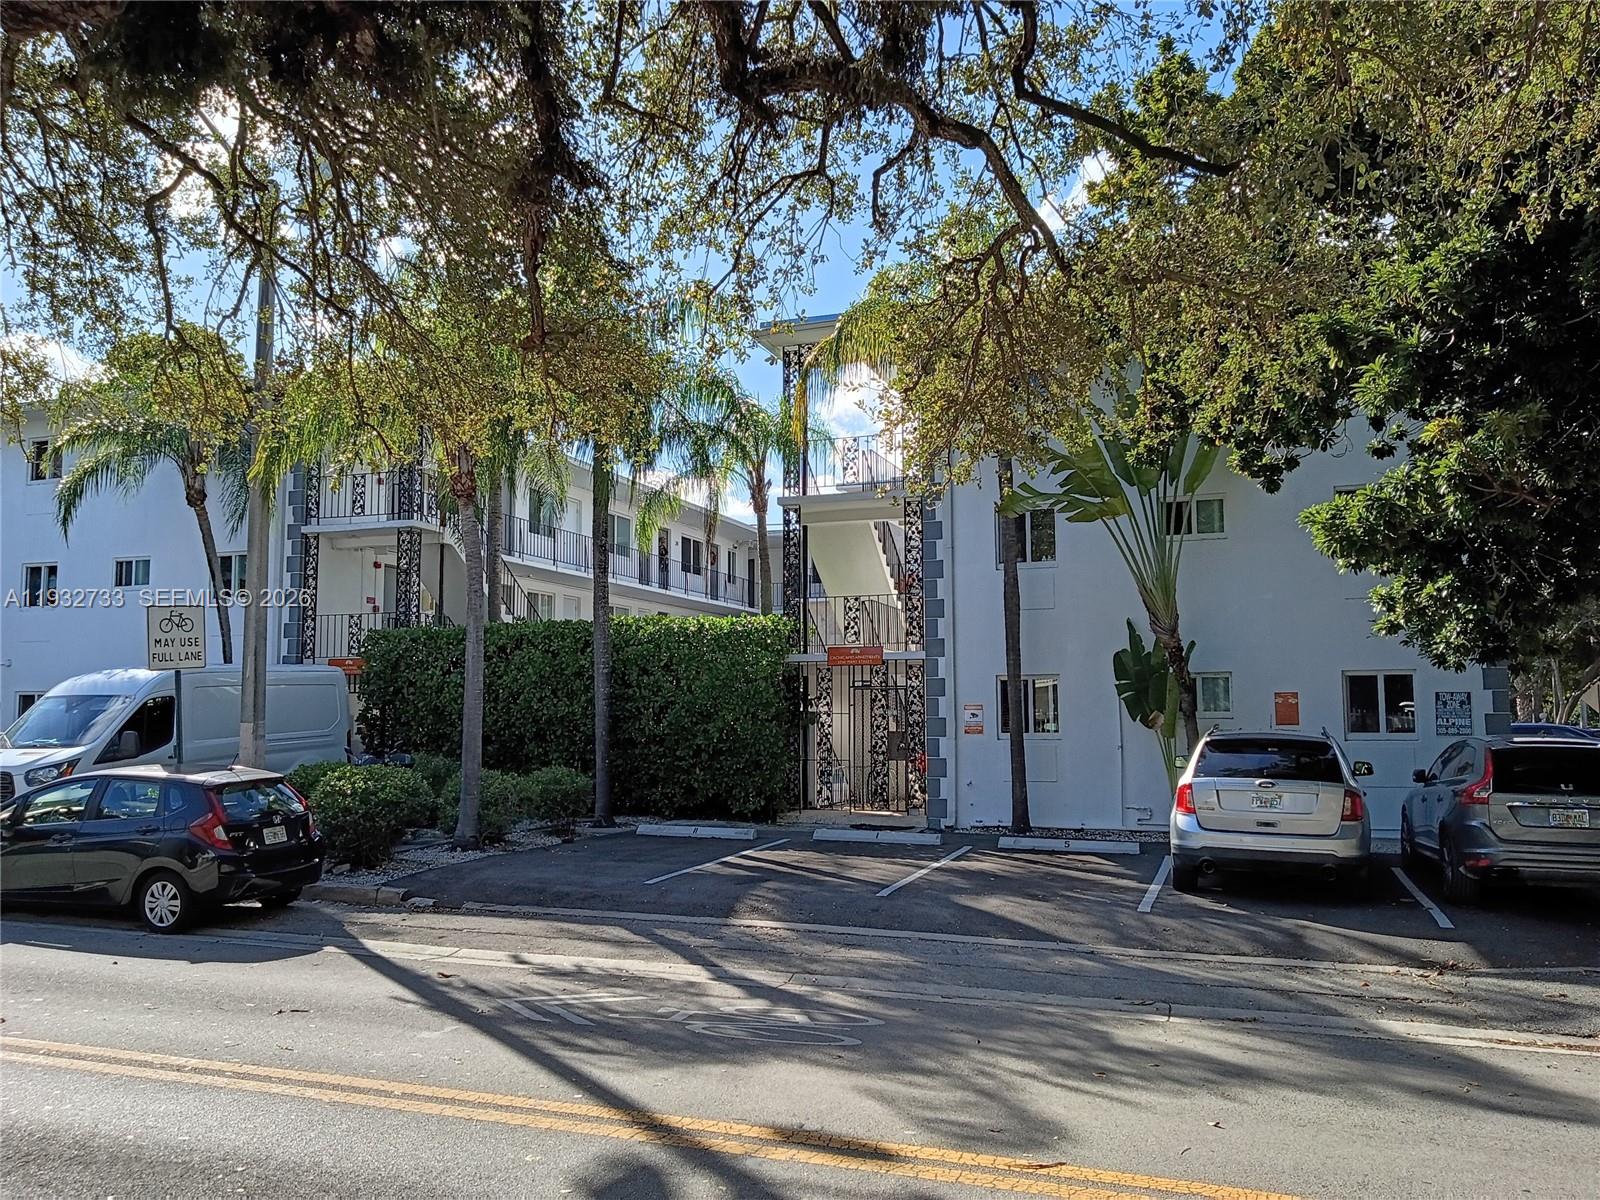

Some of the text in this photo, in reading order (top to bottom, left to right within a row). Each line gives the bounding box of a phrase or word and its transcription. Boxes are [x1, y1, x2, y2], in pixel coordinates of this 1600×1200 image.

[154, 637, 200, 648] MAY USE
[152, 651, 203, 662] FULL LANE
